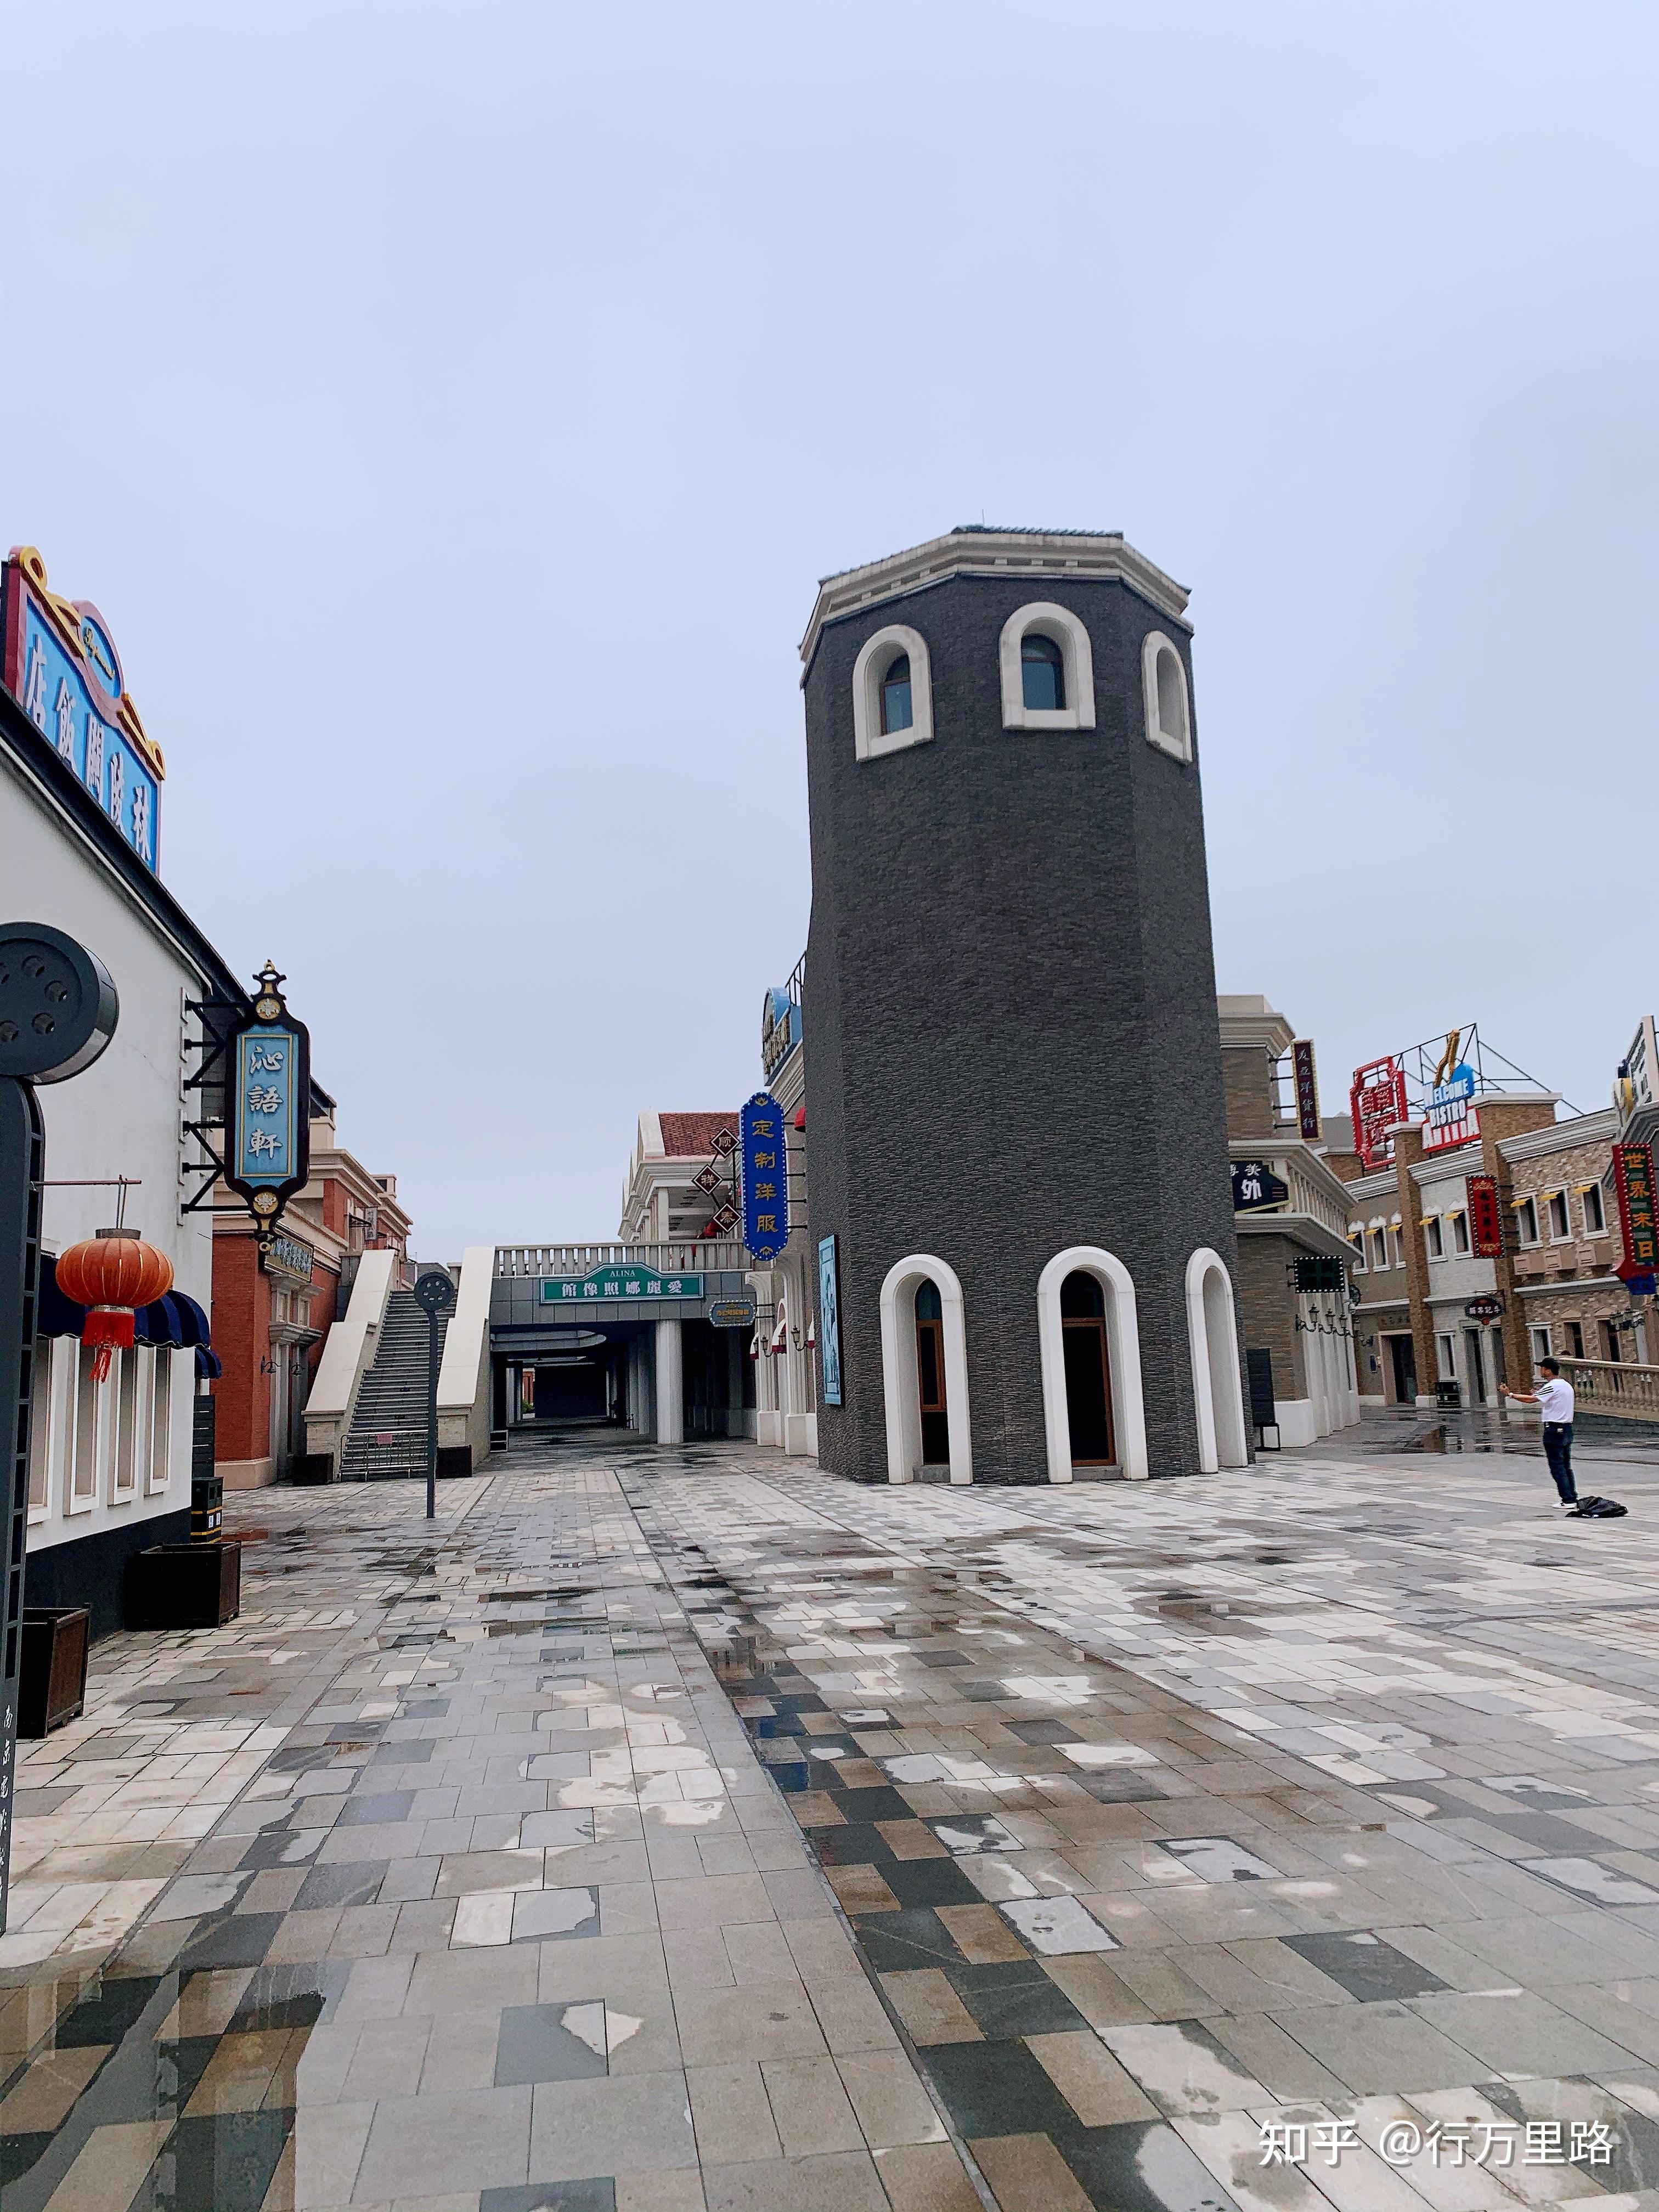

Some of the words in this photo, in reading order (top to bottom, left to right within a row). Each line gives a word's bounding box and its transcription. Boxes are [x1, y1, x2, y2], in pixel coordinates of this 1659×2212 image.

[247, 1045, 284, 1159] 沁語軒
[1429, 1099, 1466, 1128] BISTRO
[752, 1119, 779, 1233] 定制洋服
[1624, 1153, 1654, 1258] 世界末日
